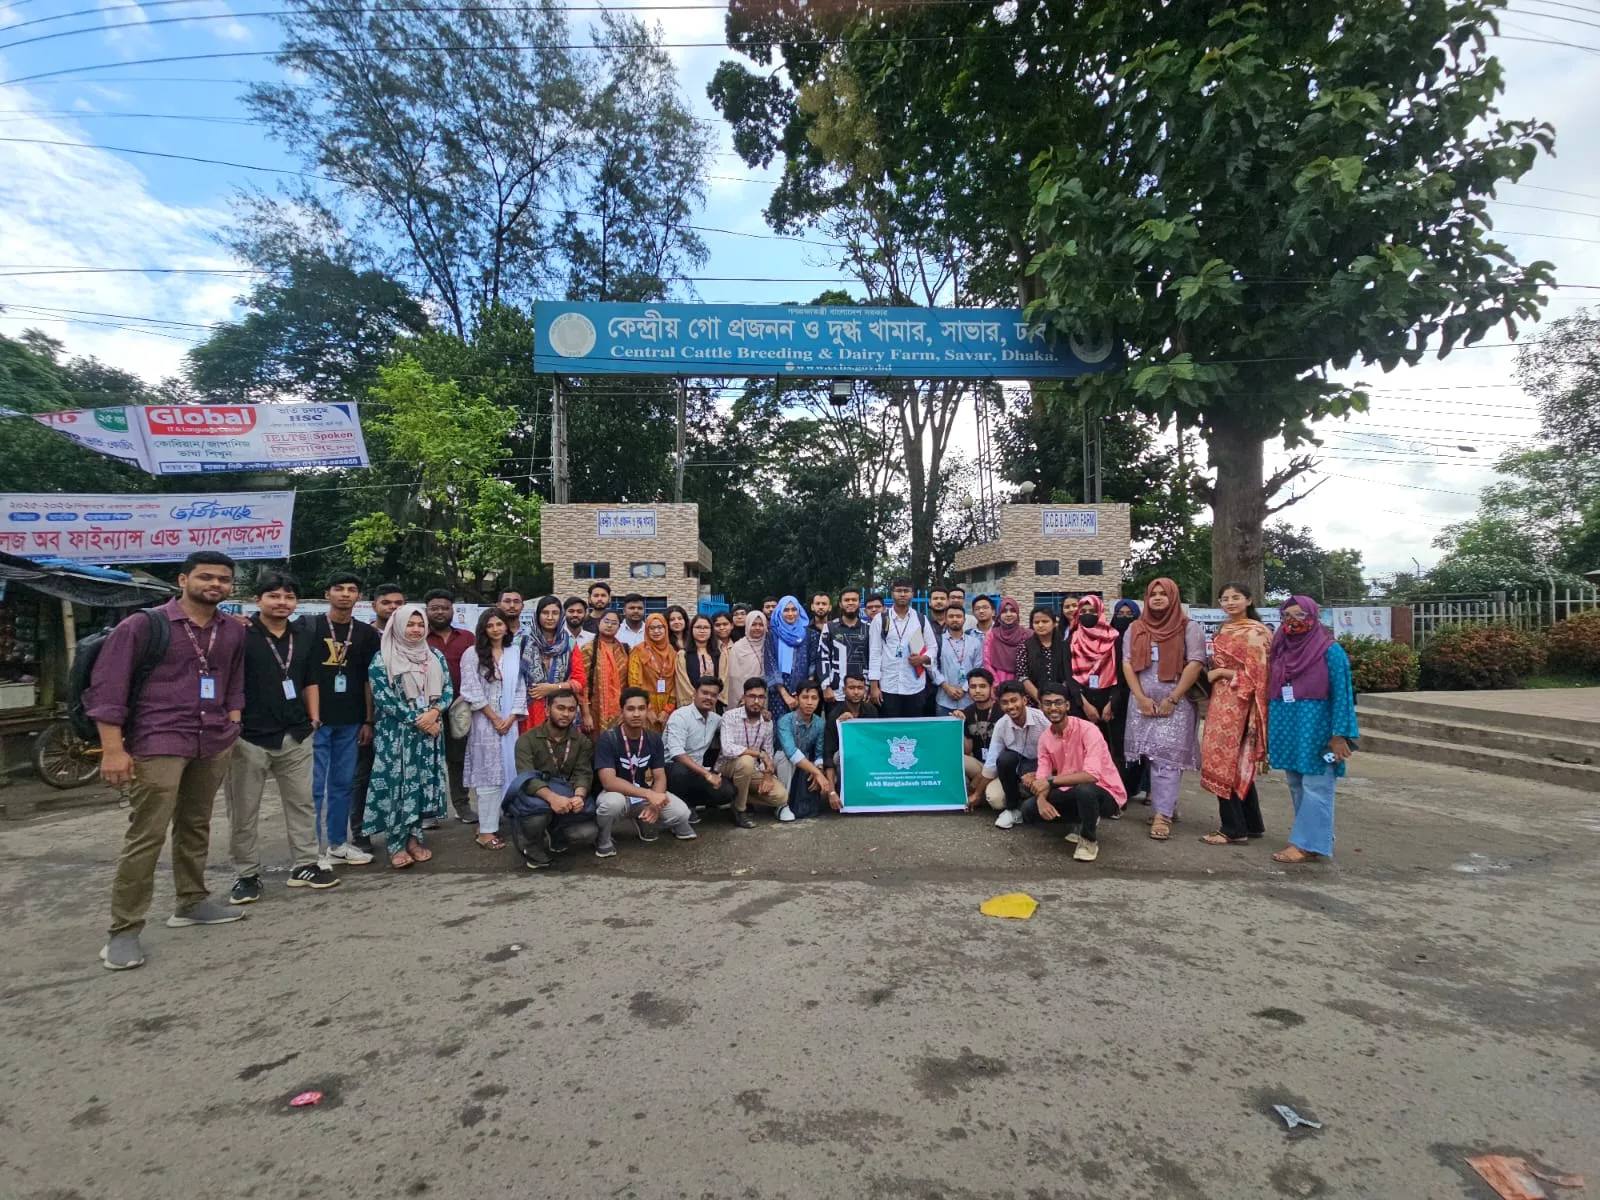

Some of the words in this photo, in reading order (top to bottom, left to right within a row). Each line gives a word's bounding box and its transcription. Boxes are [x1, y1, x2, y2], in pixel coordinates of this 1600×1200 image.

[608, 309, 681, 342] কেন্দ্রীয়
[688, 318, 722, 340] গো
[727, 318, 796, 341] প্রজনন
[803, 322, 820, 339] ও
[868, 319, 933, 346] খামার,
[940, 320, 1007, 346] সাভার,
[610, 345, 675, 359] Central
[681, 346, 733, 359] Cattle
[737, 347, 813, 361] Breeding
[818, 349, 832, 360] &
[838, 348, 885, 362] Dairy
[890, 349, 940, 362] Farm,
[944, 350, 997, 363] Savar,
[1001, 350, 1059, 362] Dhaka.
[149, 408, 252, 425] Global
[264, 433, 308, 442] IELTS
[312, 431, 353, 441] Spoken
[31, 531, 61, 551] অব
[66, 525, 145, 551] ফাইন্যান্স
[151, 529, 182, 546] এন্ড
[187, 519, 284, 547] ম্যানেজমেন্ট
